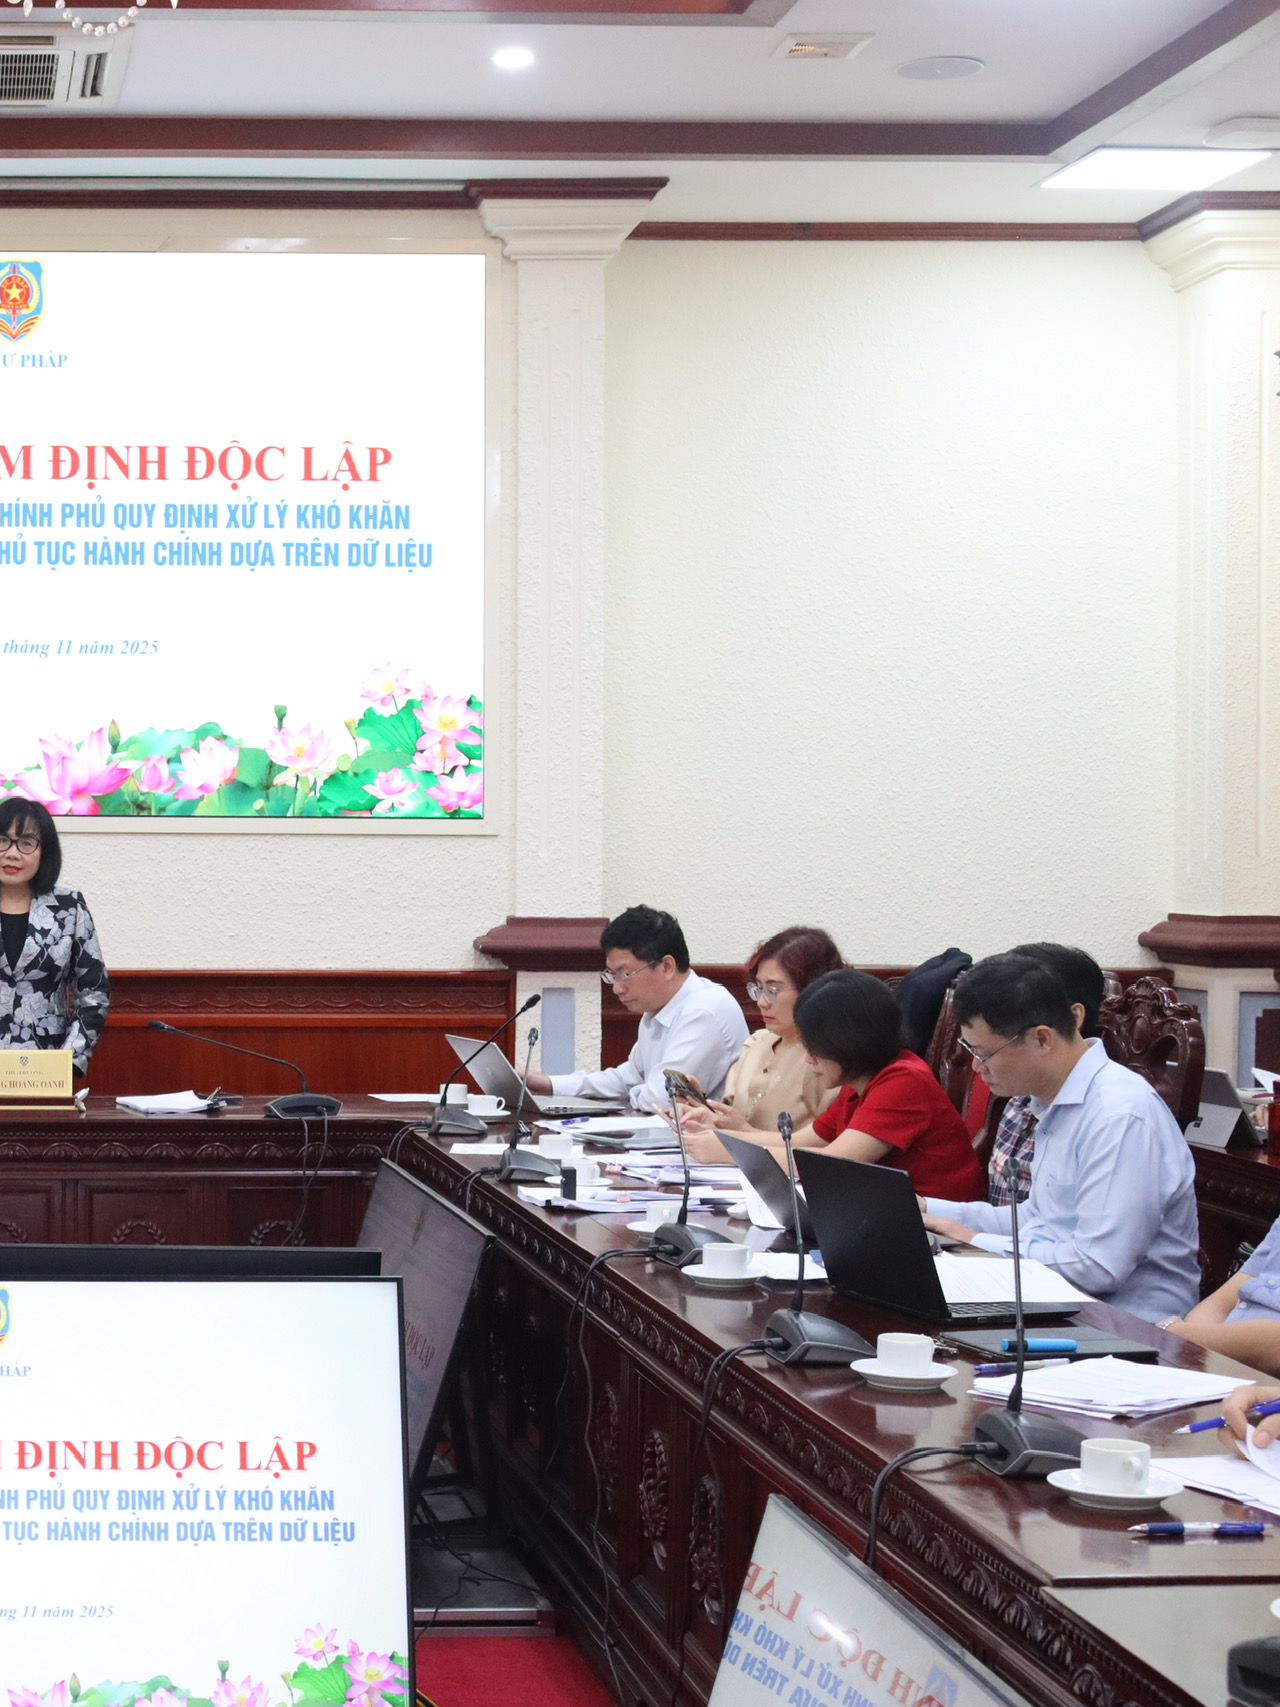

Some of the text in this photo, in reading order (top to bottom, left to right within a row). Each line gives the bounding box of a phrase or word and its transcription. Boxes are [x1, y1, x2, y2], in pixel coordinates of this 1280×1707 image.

[20, 350, 68, 368] PHÁP
[48, 444, 170, 490] ĐỊNH
[183, 440, 286, 491] ĐỘC
[300, 440, 392, 492] LẬP
[60, 494, 105, 528] PHỦ
[113, 502, 157, 531] QUY
[163, 503, 219, 534] ĐỊNH
[226, 495, 259, 529] XỬ
[263, 499, 289, 529] LÝ
[296, 499, 341, 529] KHÓ
[349, 499, 410, 530] KHĂN
[33, 541, 76, 571] TỤC
[84, 536, 145, 566] HÀNH
[153, 536, 222, 567] CHÍNH
[230, 539, 275, 572] DỰA
[282, 537, 340, 567] TRÊN
[347, 538, 380, 567] DỮ
[385, 538, 433, 573] LIỆU
[3, 640, 50, 658] tháng
[56, 640, 72, 655] 11
[78, 641, 114, 655] năm
[120, 640, 159, 655] 2025
[40, 1080, 65, 1089] OANH
[14, 1440, 121, 1478] ĐỊNH
[133, 1436, 224, 1479] ĐỘC
[236, 1436, 318, 1479] LẬP
[26, 1483, 65, 1510] PHỦ
[73, 1490, 110, 1512] QUY
[117, 1490, 165, 1515] ĐỊNH
[172, 1483, 200, 1511] XỬ
[205, 1486, 227, 1511] LÝ
[234, 1486, 273, 1511] KHÓ
[280, 1486, 335, 1511] KHĂN
[3, 1521, 39, 1545] TỤC
[47, 1517, 101, 1541] HÀNH
[108, 1517, 169, 1542] CHÍNH
[176, 1520, 216, 1546] DỰA
[222, 1517, 273, 1542] TRÊN
[280, 1518, 308, 1542] DỮ
[313, 1517, 355, 1547] LIỆU
[22, 1605, 37, 1618] 11
[42, 1606, 74, 1618] năm
[79, 1605, 114, 1618] 2025
